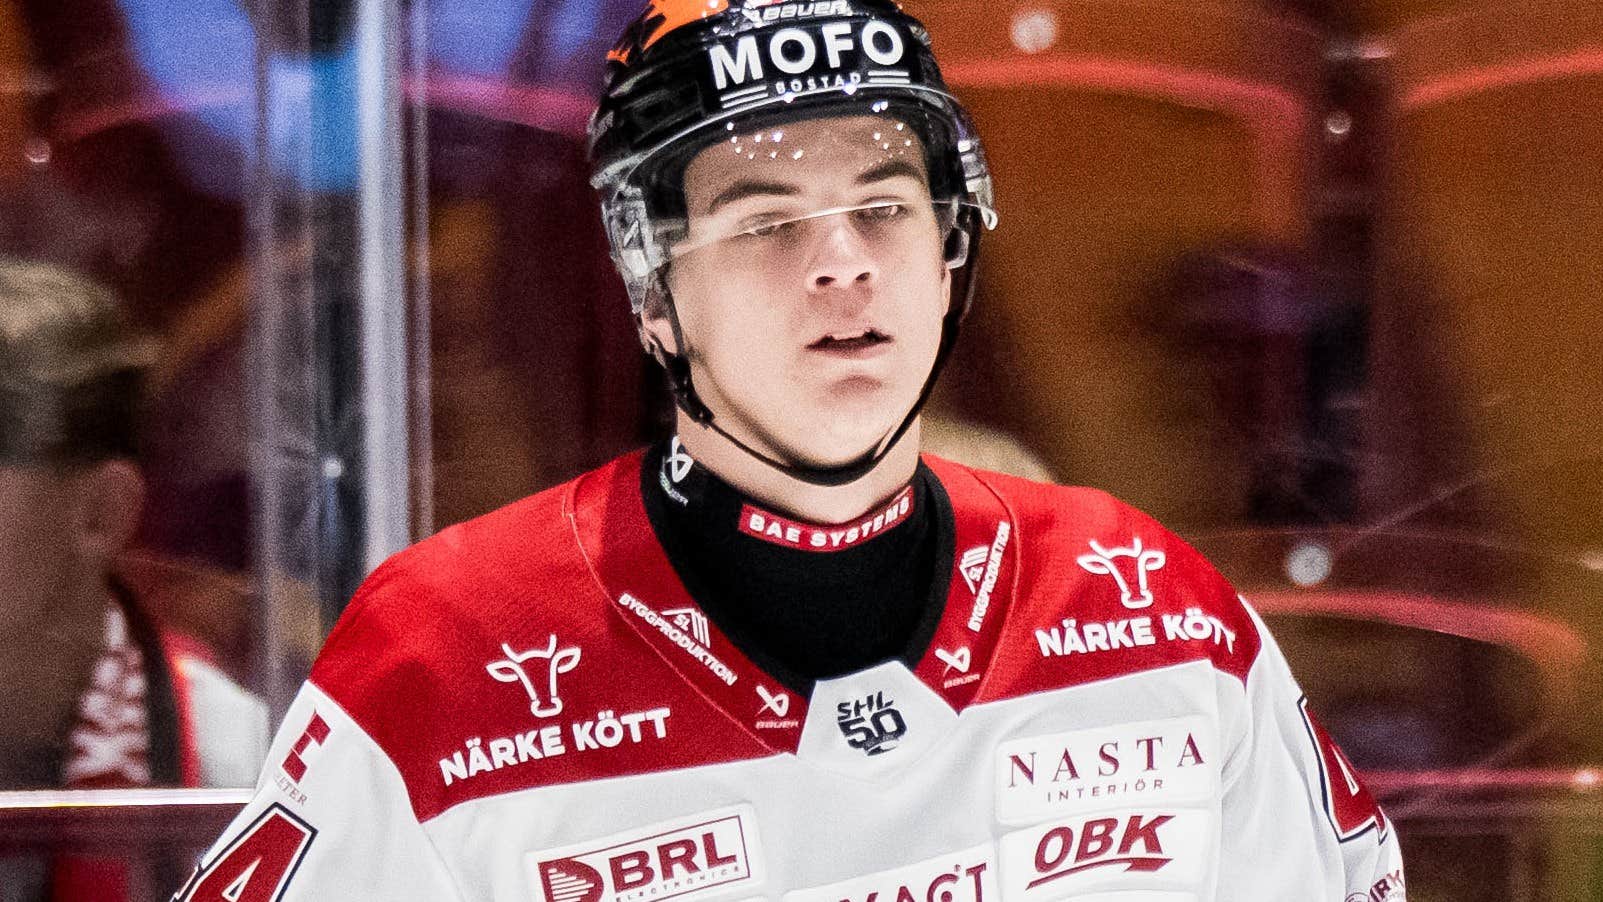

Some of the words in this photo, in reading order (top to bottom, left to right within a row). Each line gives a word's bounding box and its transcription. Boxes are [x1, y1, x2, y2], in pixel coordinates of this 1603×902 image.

[762, 0, 850, 20] BAUER
[708, 19, 905, 90] MOFO
[775, 72, 862, 95] BOSTAD
[749, 513, 801, 544] BAE
[810, 496, 910, 547] SYSTEMS
[618, 592, 738, 686] BYGGPRODUKTION
[1034, 618, 1157, 658] NÄRKE
[837, 690, 894, 721] SHL
[838, 708, 908, 751] 50
[439, 721, 566, 787] NÄRKE
[573, 706, 671, 752] KÖTT
[1008, 732, 1206, 788] NASTA
[1047, 778, 1164, 803] INTERIÖR
[608, 832, 737, 893] BRL
[1033, 815, 1177, 874] OBK
